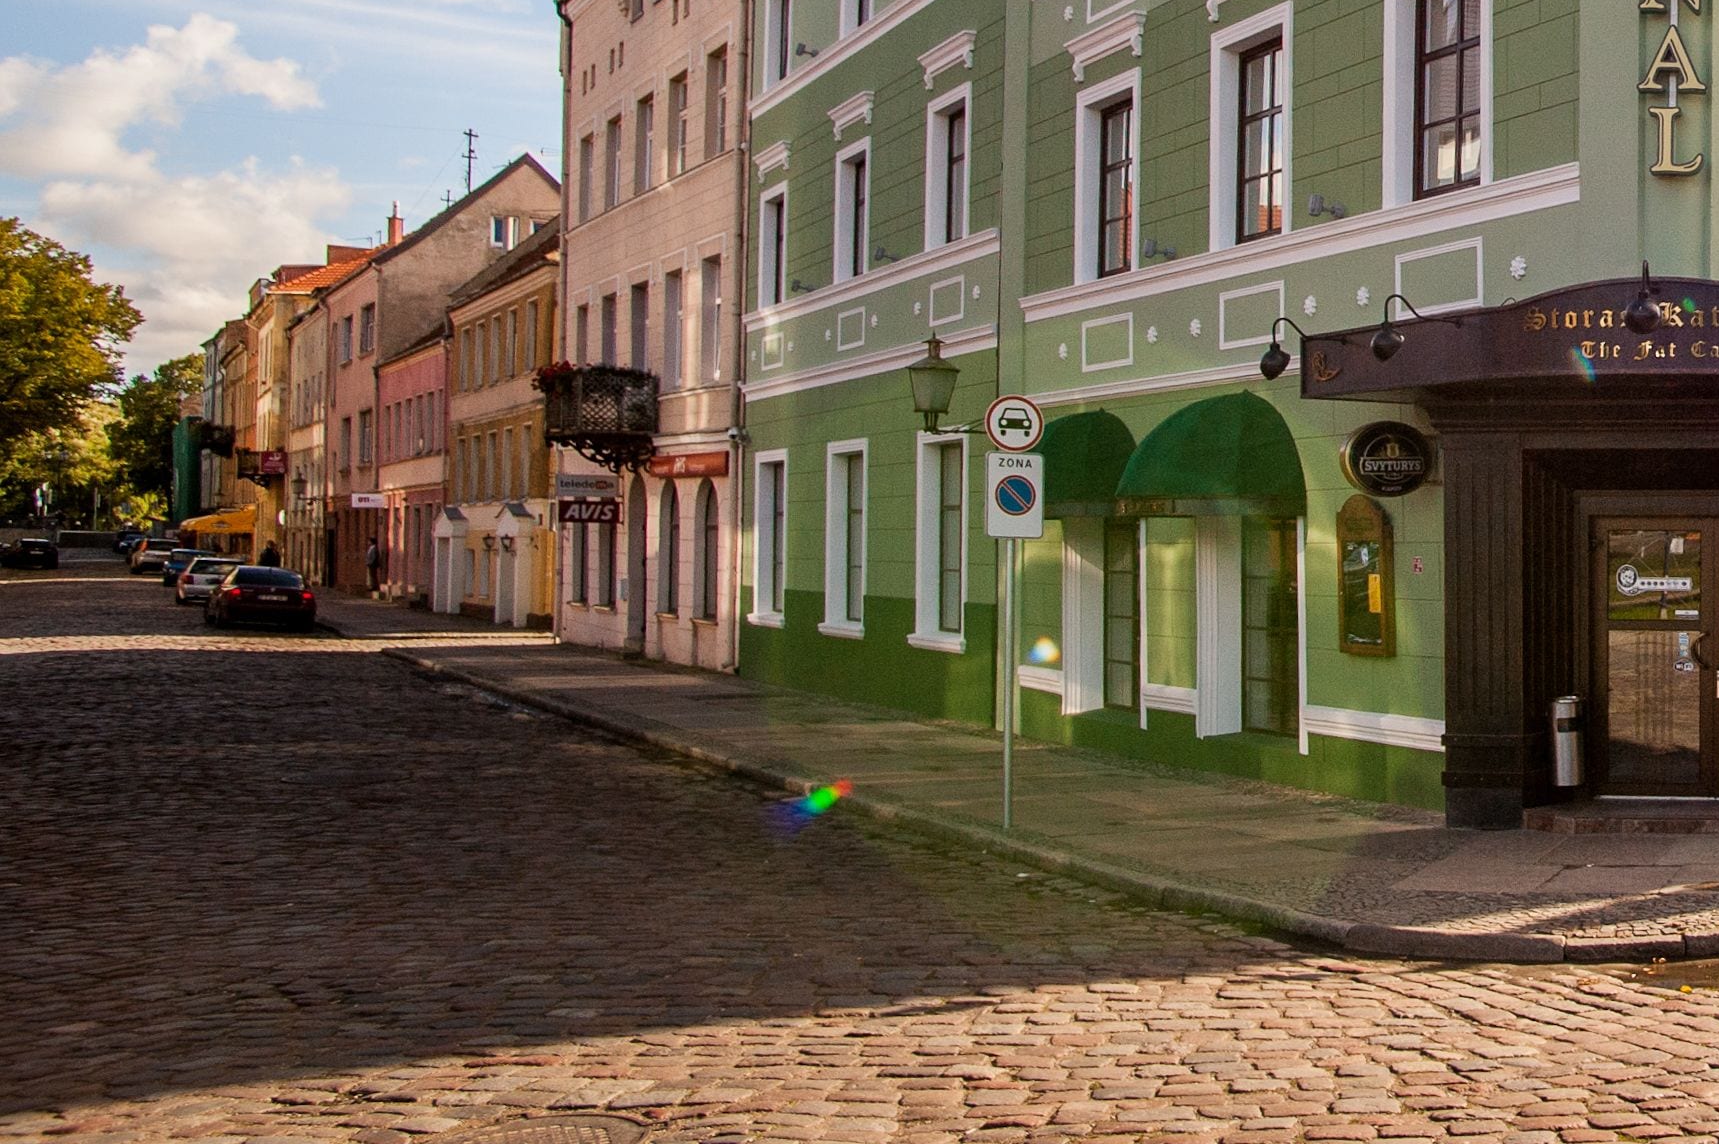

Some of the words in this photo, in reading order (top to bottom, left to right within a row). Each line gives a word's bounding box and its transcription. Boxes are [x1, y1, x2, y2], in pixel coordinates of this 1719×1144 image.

[1580, 340, 1621, 360] The
[1633, 340, 1677, 361] Fat
[998, 457, 1033, 469] ZONA
[564, 504, 616, 520] AVIS
